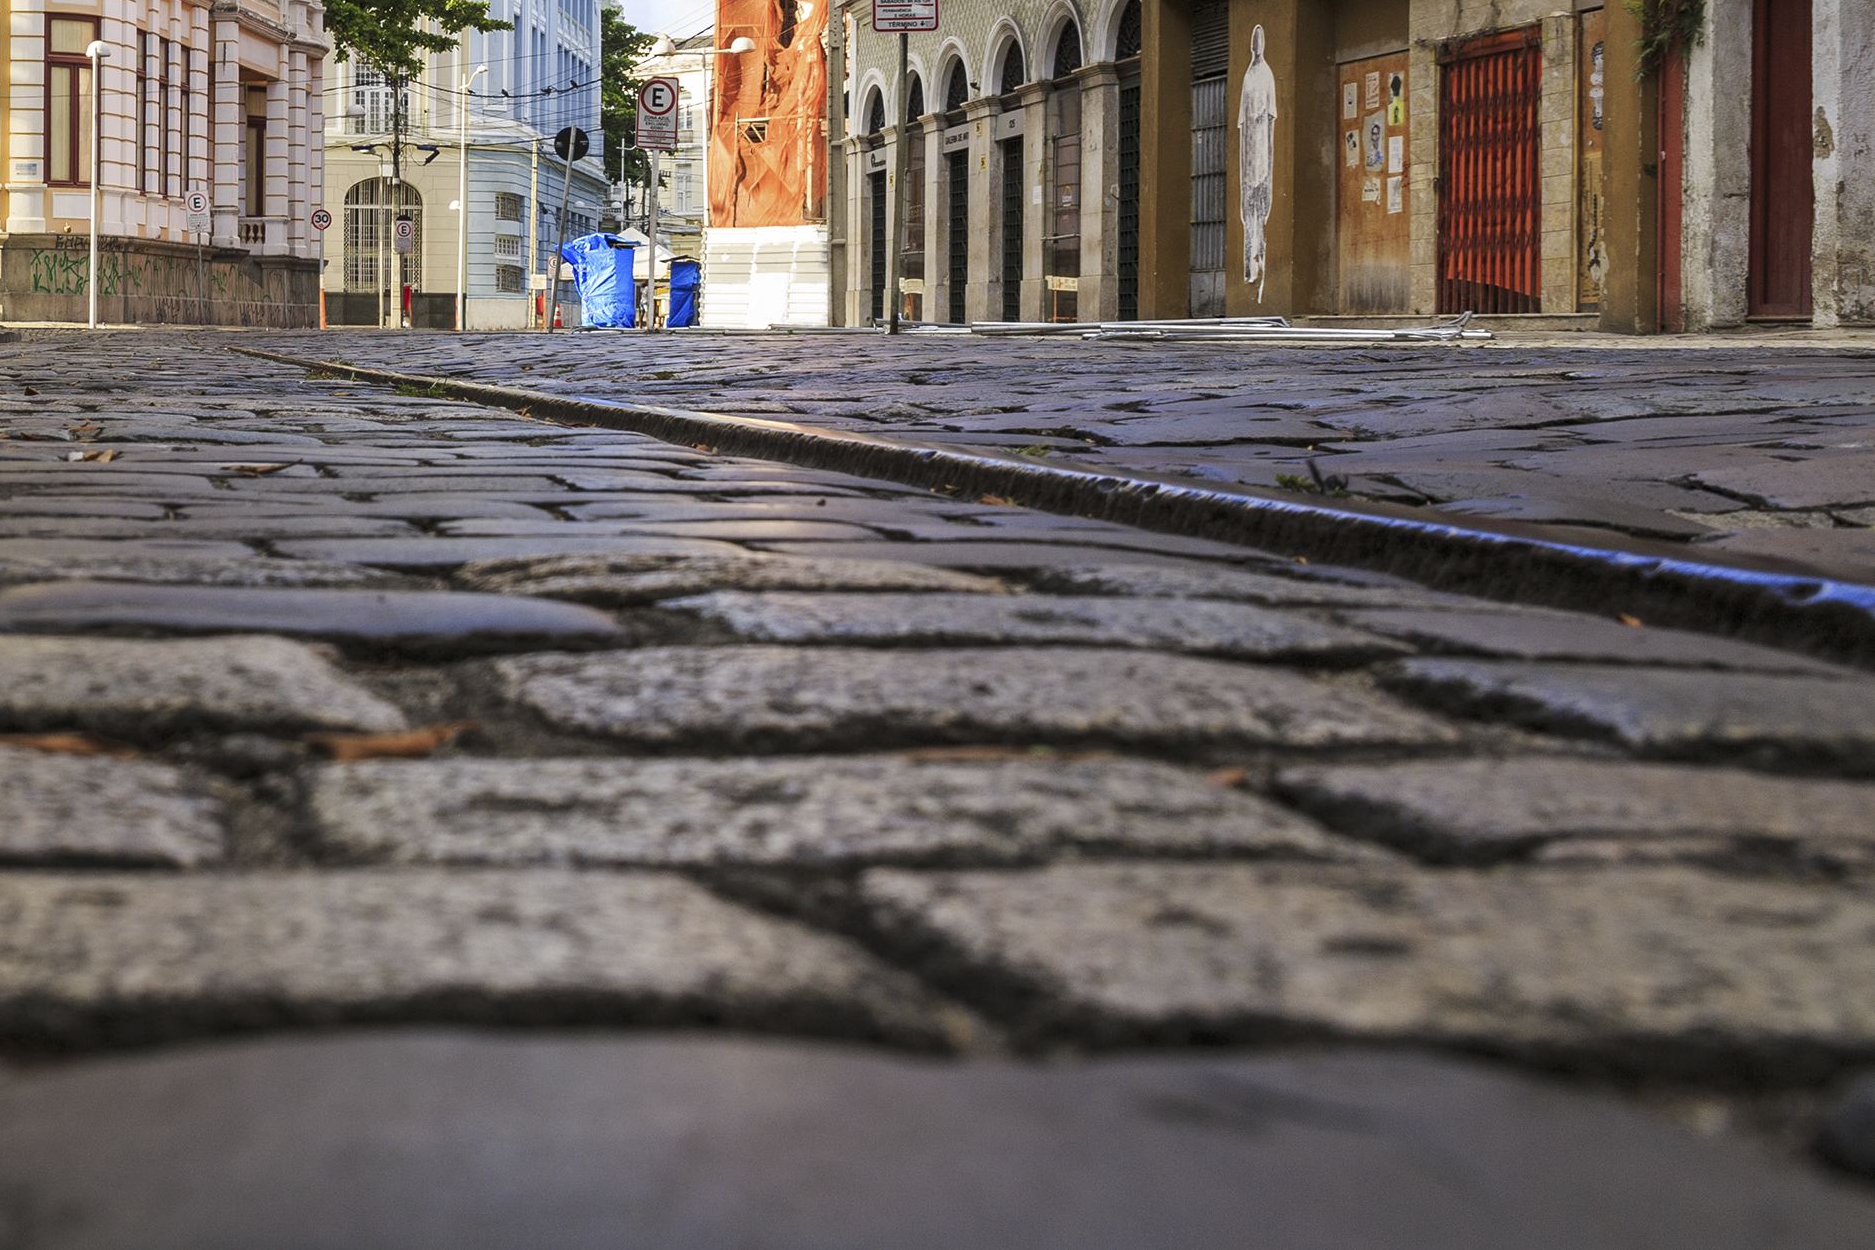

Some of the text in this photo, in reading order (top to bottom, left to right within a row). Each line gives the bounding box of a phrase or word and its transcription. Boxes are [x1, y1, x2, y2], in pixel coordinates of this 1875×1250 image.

[652, 88, 664, 107] E
[194, 198, 201, 208] E
[315, 214, 329, 224] 30
[401, 225, 407, 234] E
